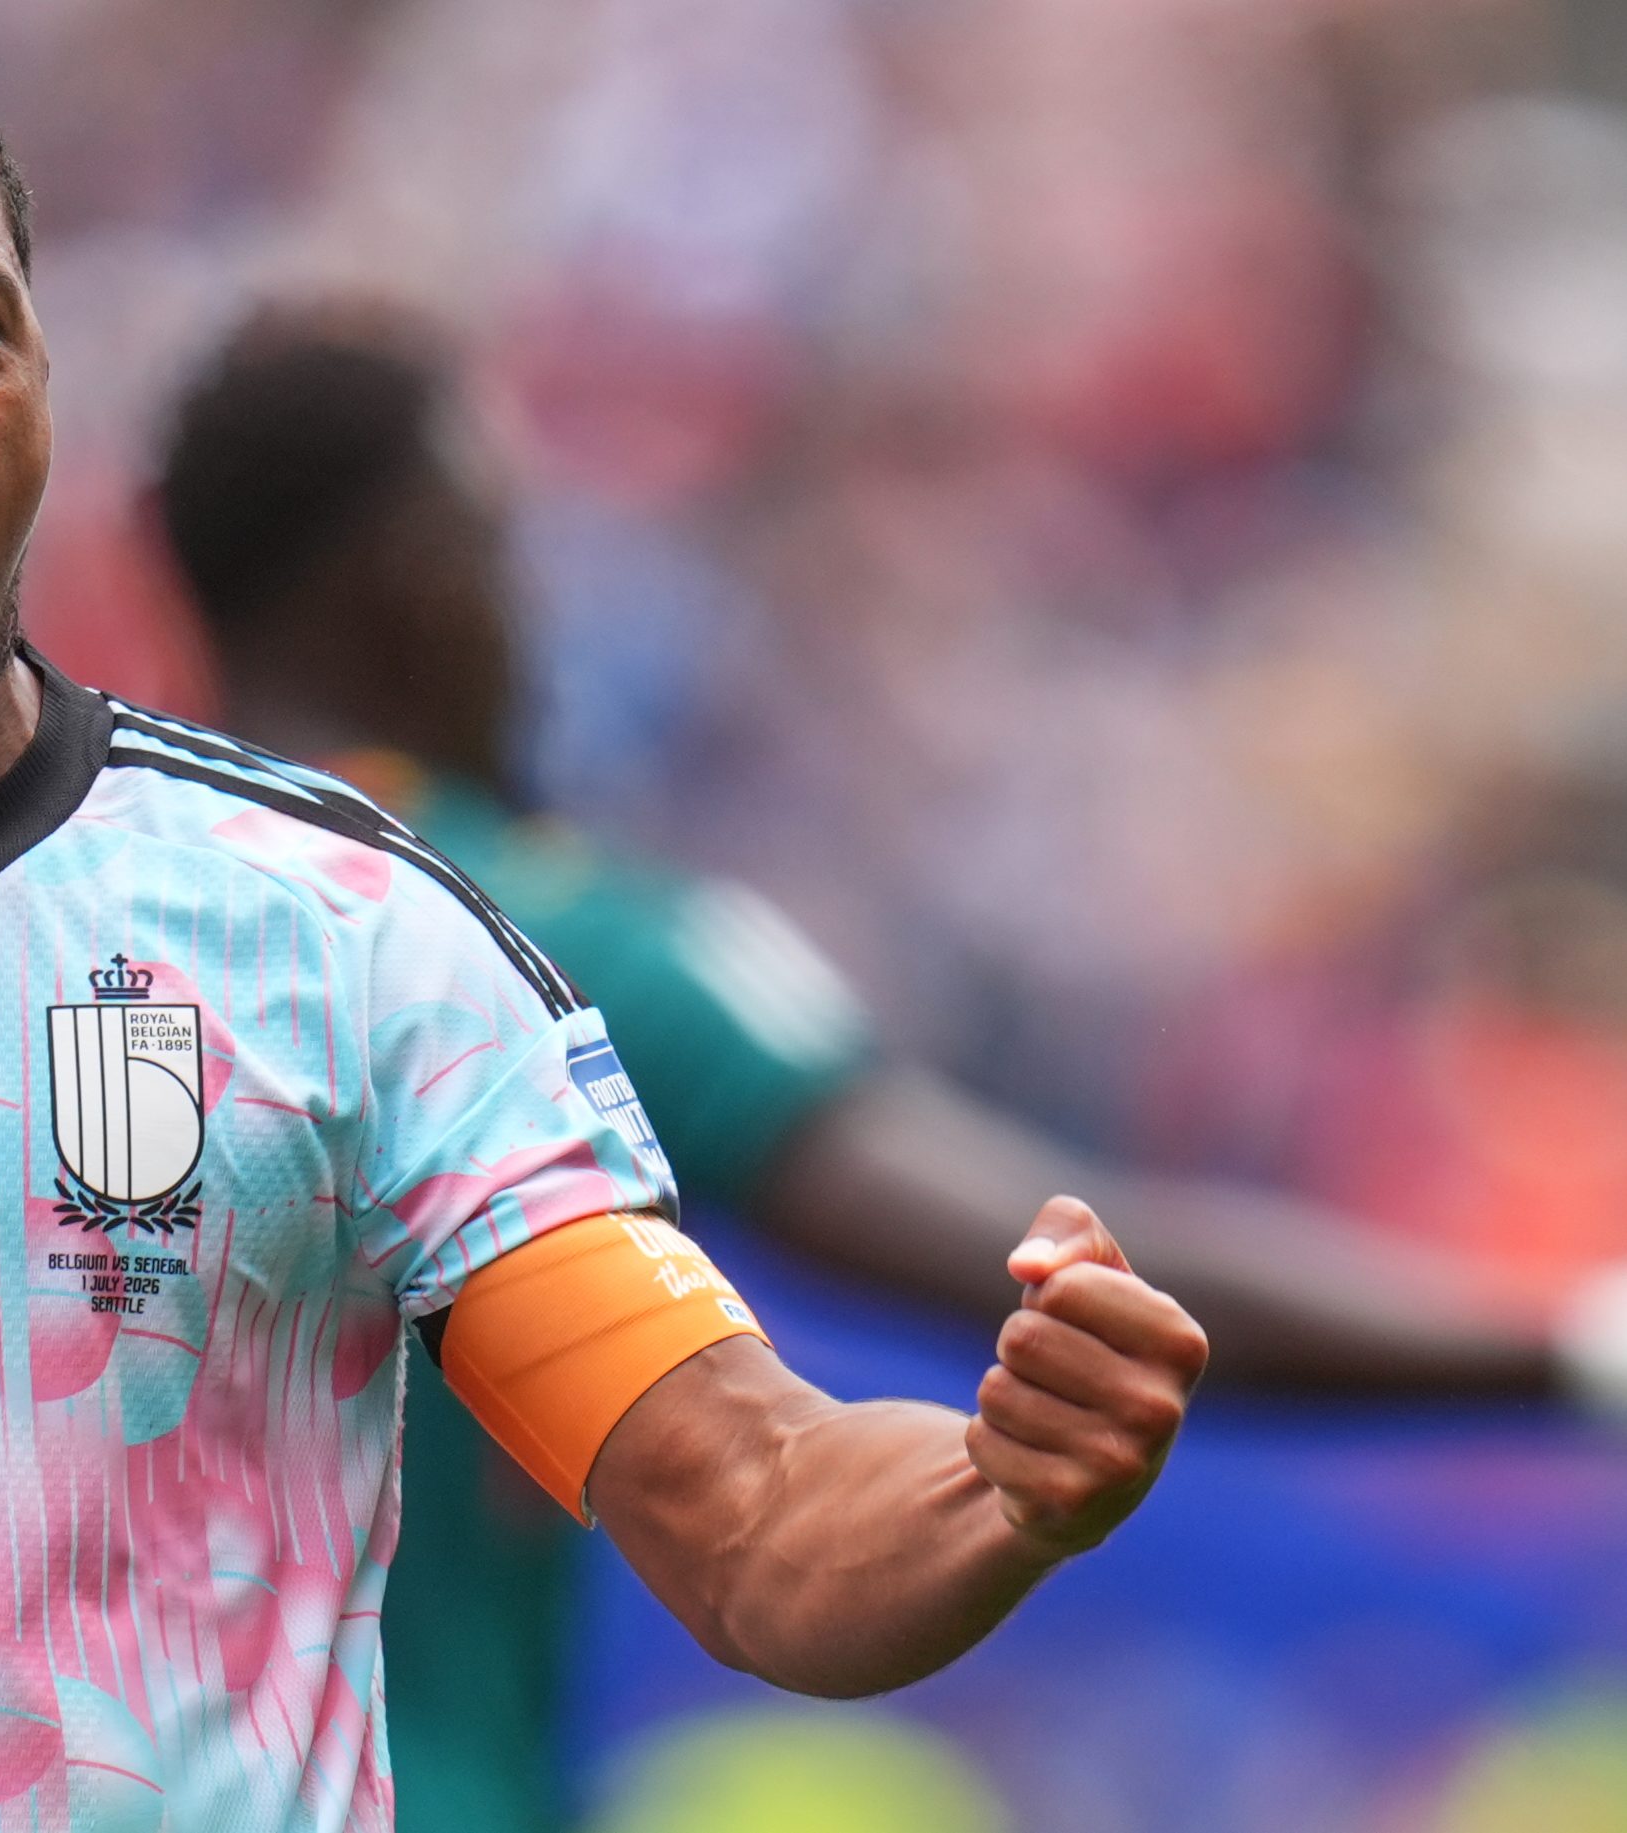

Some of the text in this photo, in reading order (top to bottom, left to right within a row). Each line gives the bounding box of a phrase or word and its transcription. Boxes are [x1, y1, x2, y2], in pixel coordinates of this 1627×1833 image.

[130, 1013, 175, 1024] ROYAL
[131, 1026, 191, 1037] BELGIAN
[587, 1073, 636, 1109] FOOTB
[48, 1254, 190, 1276] BELGIUM VS SENEGAL
[81, 1275, 160, 1295] 1 JULY 2026
[91, 1296, 146, 1314] SEATTLE
